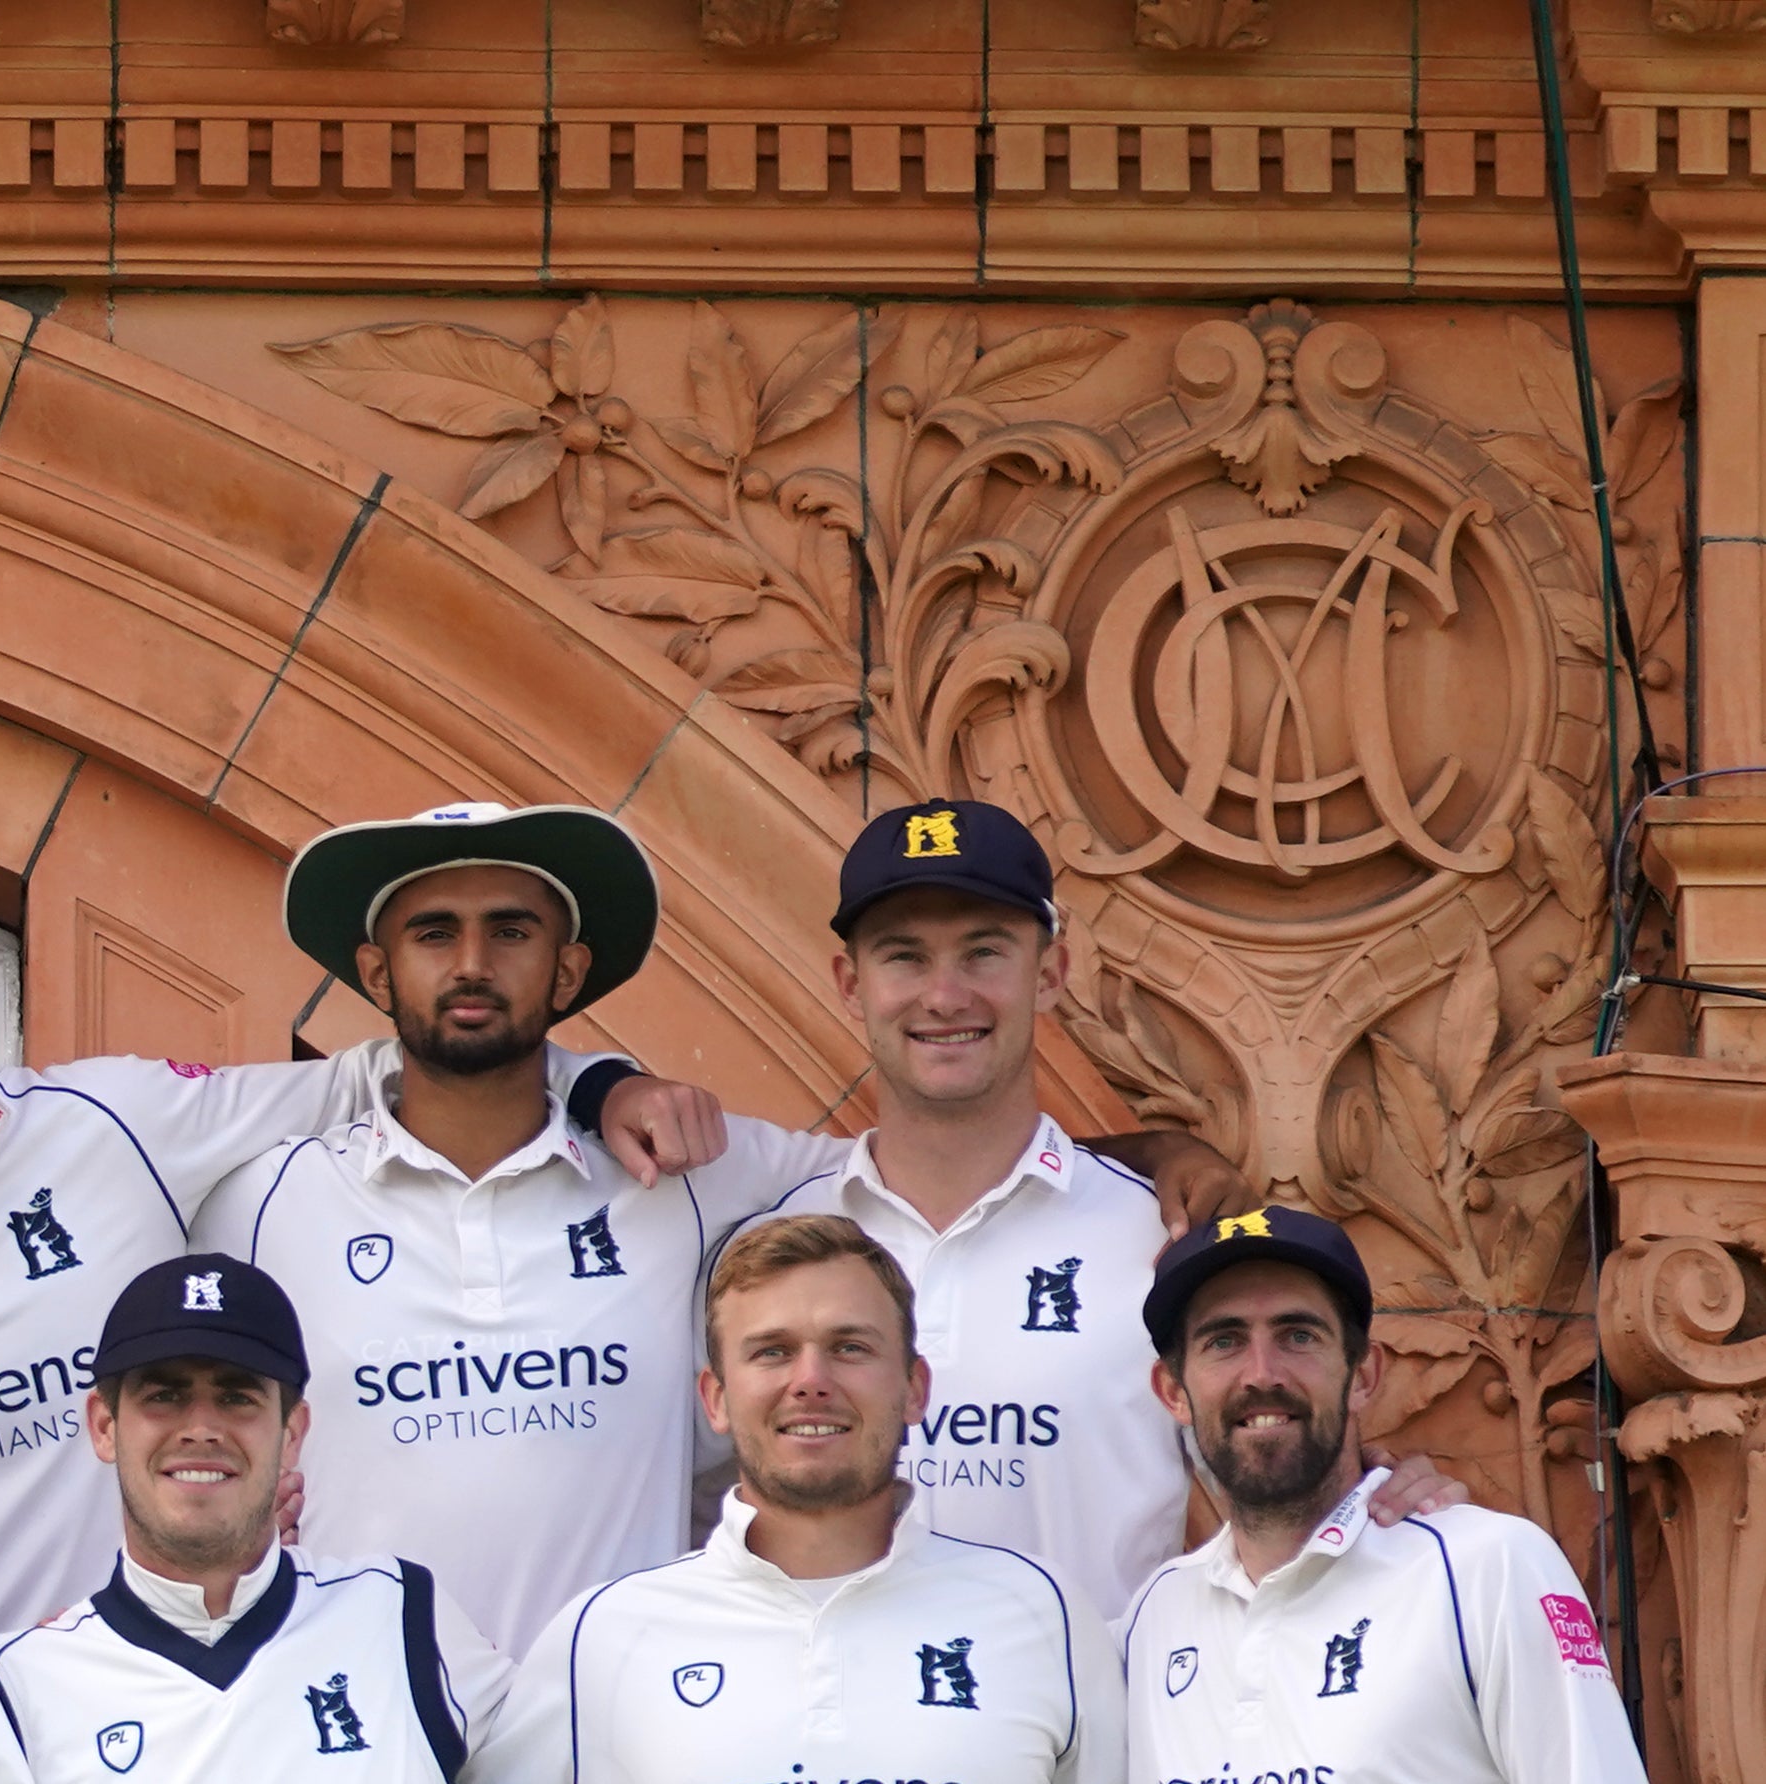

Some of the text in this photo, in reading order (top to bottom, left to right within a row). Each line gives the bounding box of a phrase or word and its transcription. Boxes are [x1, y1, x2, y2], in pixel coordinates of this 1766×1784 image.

[355, 1242, 377, 1256] PL
[354, 1341, 628, 1407] scrivens
[393, 1400, 597, 1444] OPTICIANS
[901, 1402, 1061, 1447] vens
[901, 1458, 1026, 1488] ICIANS
[682, 1670, 707, 1682] PL
[106, 1732, 128, 1748] PL
